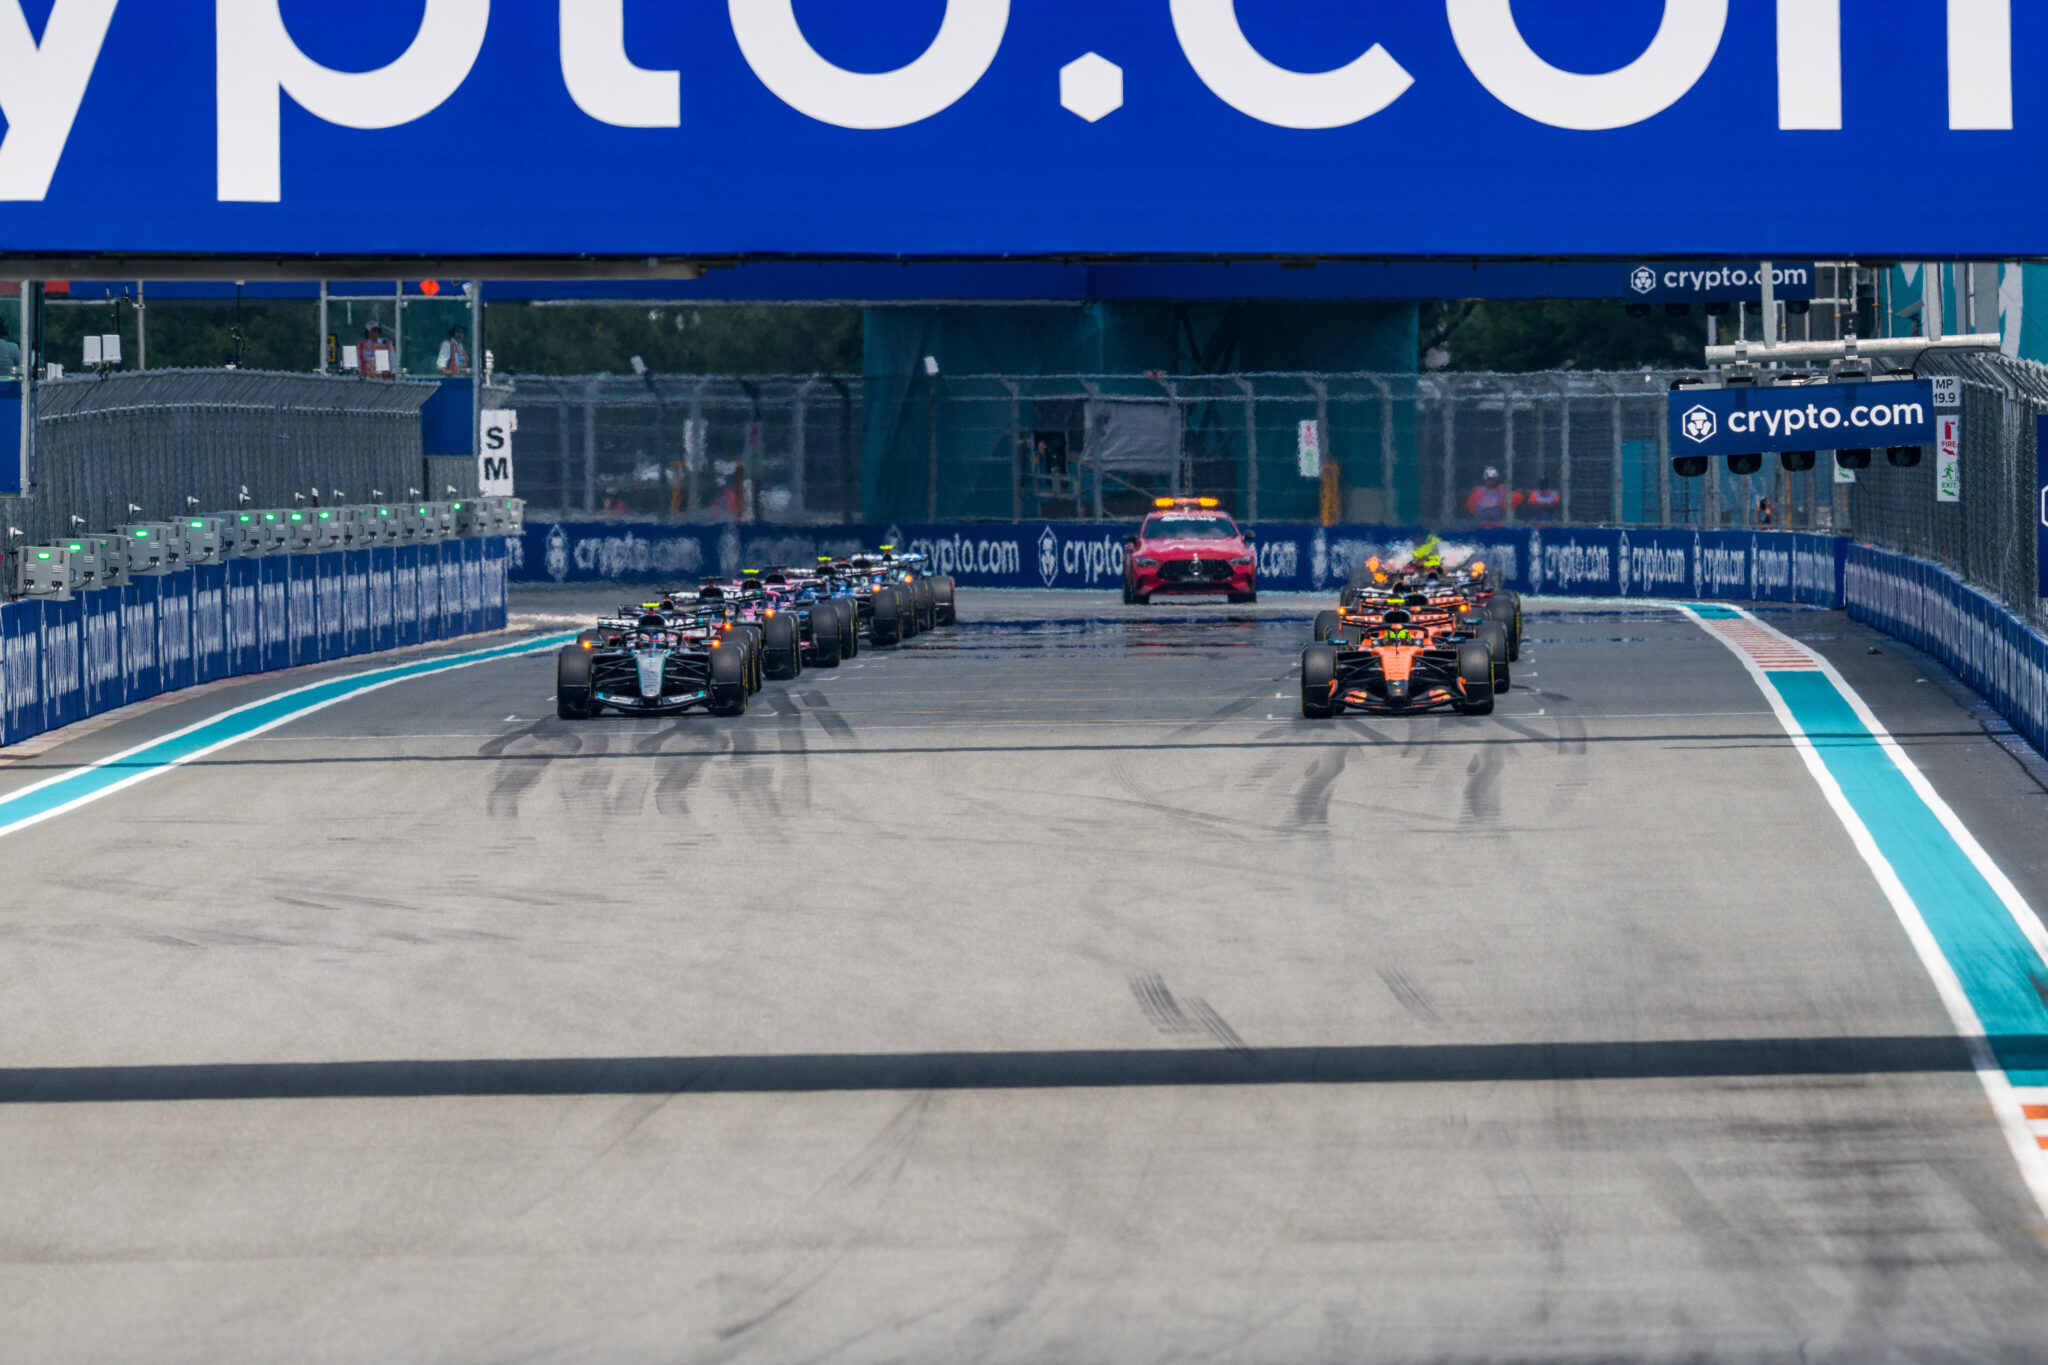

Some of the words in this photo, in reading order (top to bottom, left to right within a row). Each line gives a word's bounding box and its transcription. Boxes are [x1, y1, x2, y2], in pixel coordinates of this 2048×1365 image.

[1935, 379, 1954, 389] MP
[1934, 392, 1956, 404] 19.9
[1728, 402, 1924, 435] crypto.com
[1063, 533, 1124, 583] crypto
